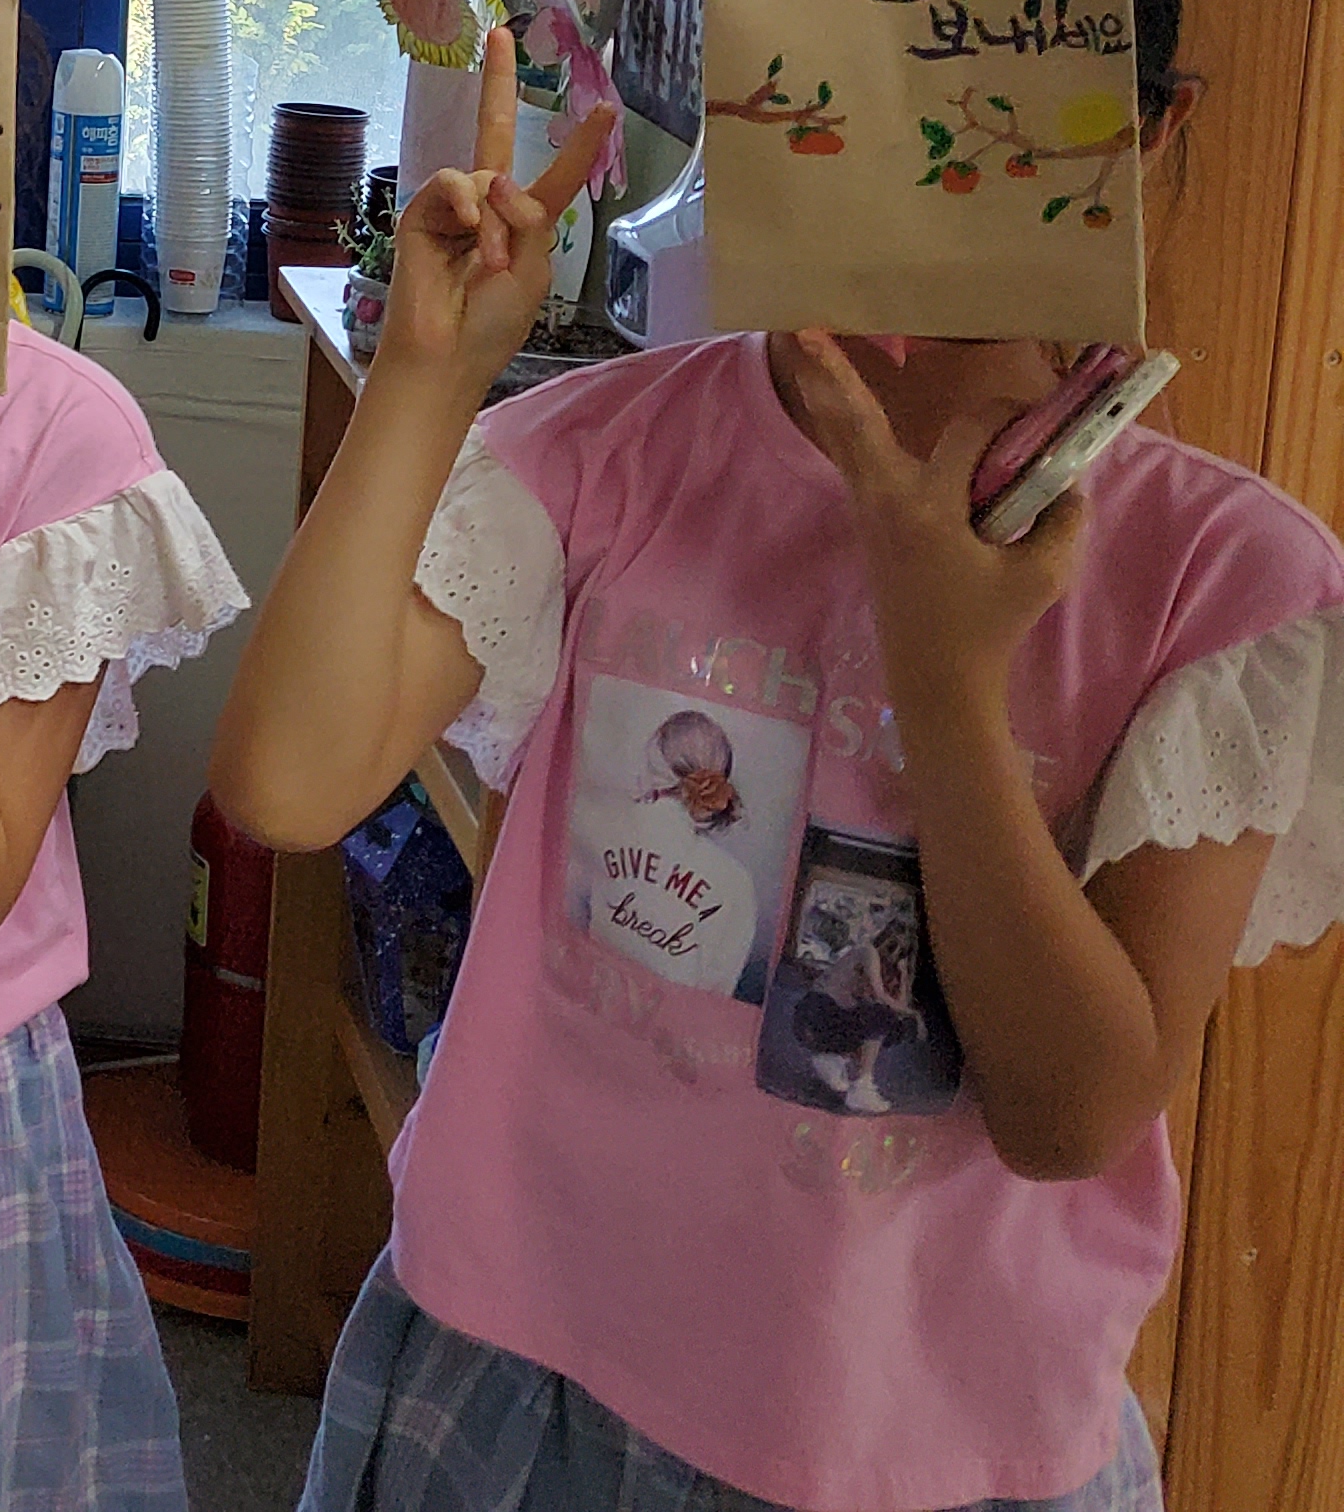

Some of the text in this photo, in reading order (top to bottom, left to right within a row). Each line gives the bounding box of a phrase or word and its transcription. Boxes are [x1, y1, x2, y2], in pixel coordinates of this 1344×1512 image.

[906, 0, 1133, 61] 보내세요
[604, 848, 660, 883] GIVE
[664, 864, 711, 909] ME
[608, 892, 698, 955] break
